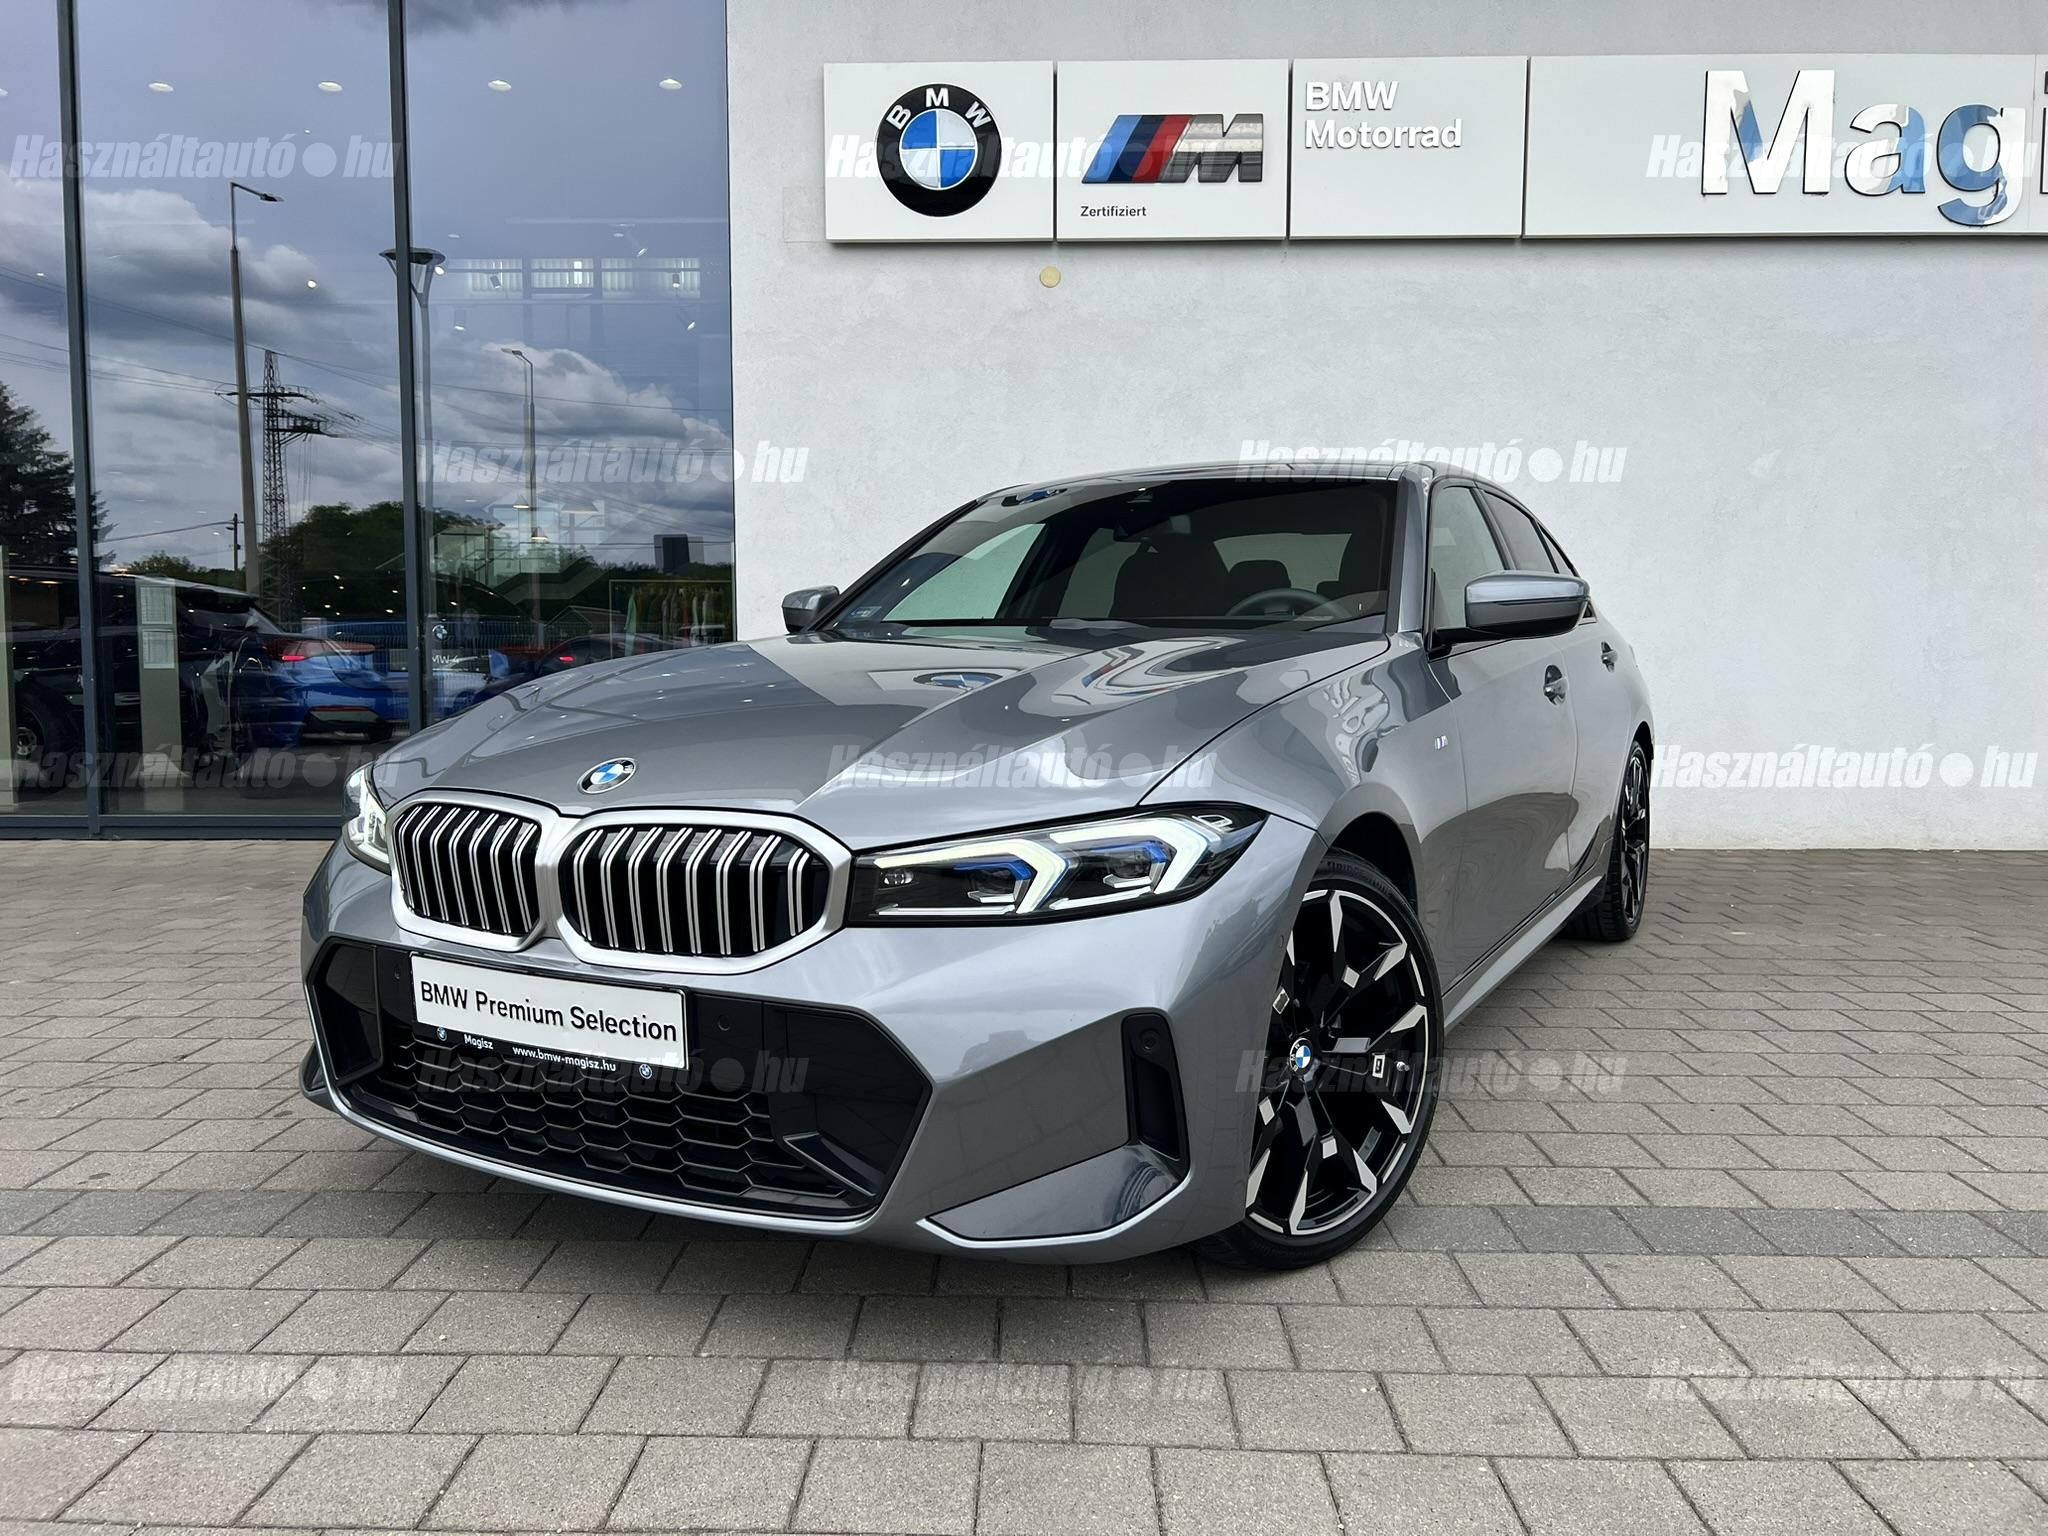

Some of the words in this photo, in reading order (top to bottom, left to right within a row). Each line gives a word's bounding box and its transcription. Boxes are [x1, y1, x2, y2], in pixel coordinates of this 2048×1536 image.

[886, 87, 992, 130] BMW
[1305, 81, 1399, 111] BMW
[1305, 119, 1462, 149] Motorrad
[1701, 69, 2047, 226] Mag
[1080, 205, 1147, 217] Zertifiziert
[420, 981, 468, 1009] BMW
[475, 990, 564, 1027] Premium
[569, 1005, 678, 1042] Selection
[464, 1034, 494, 1050] Magisz
[512, 1046, 617, 1072] www.bmw-magisz.hu
